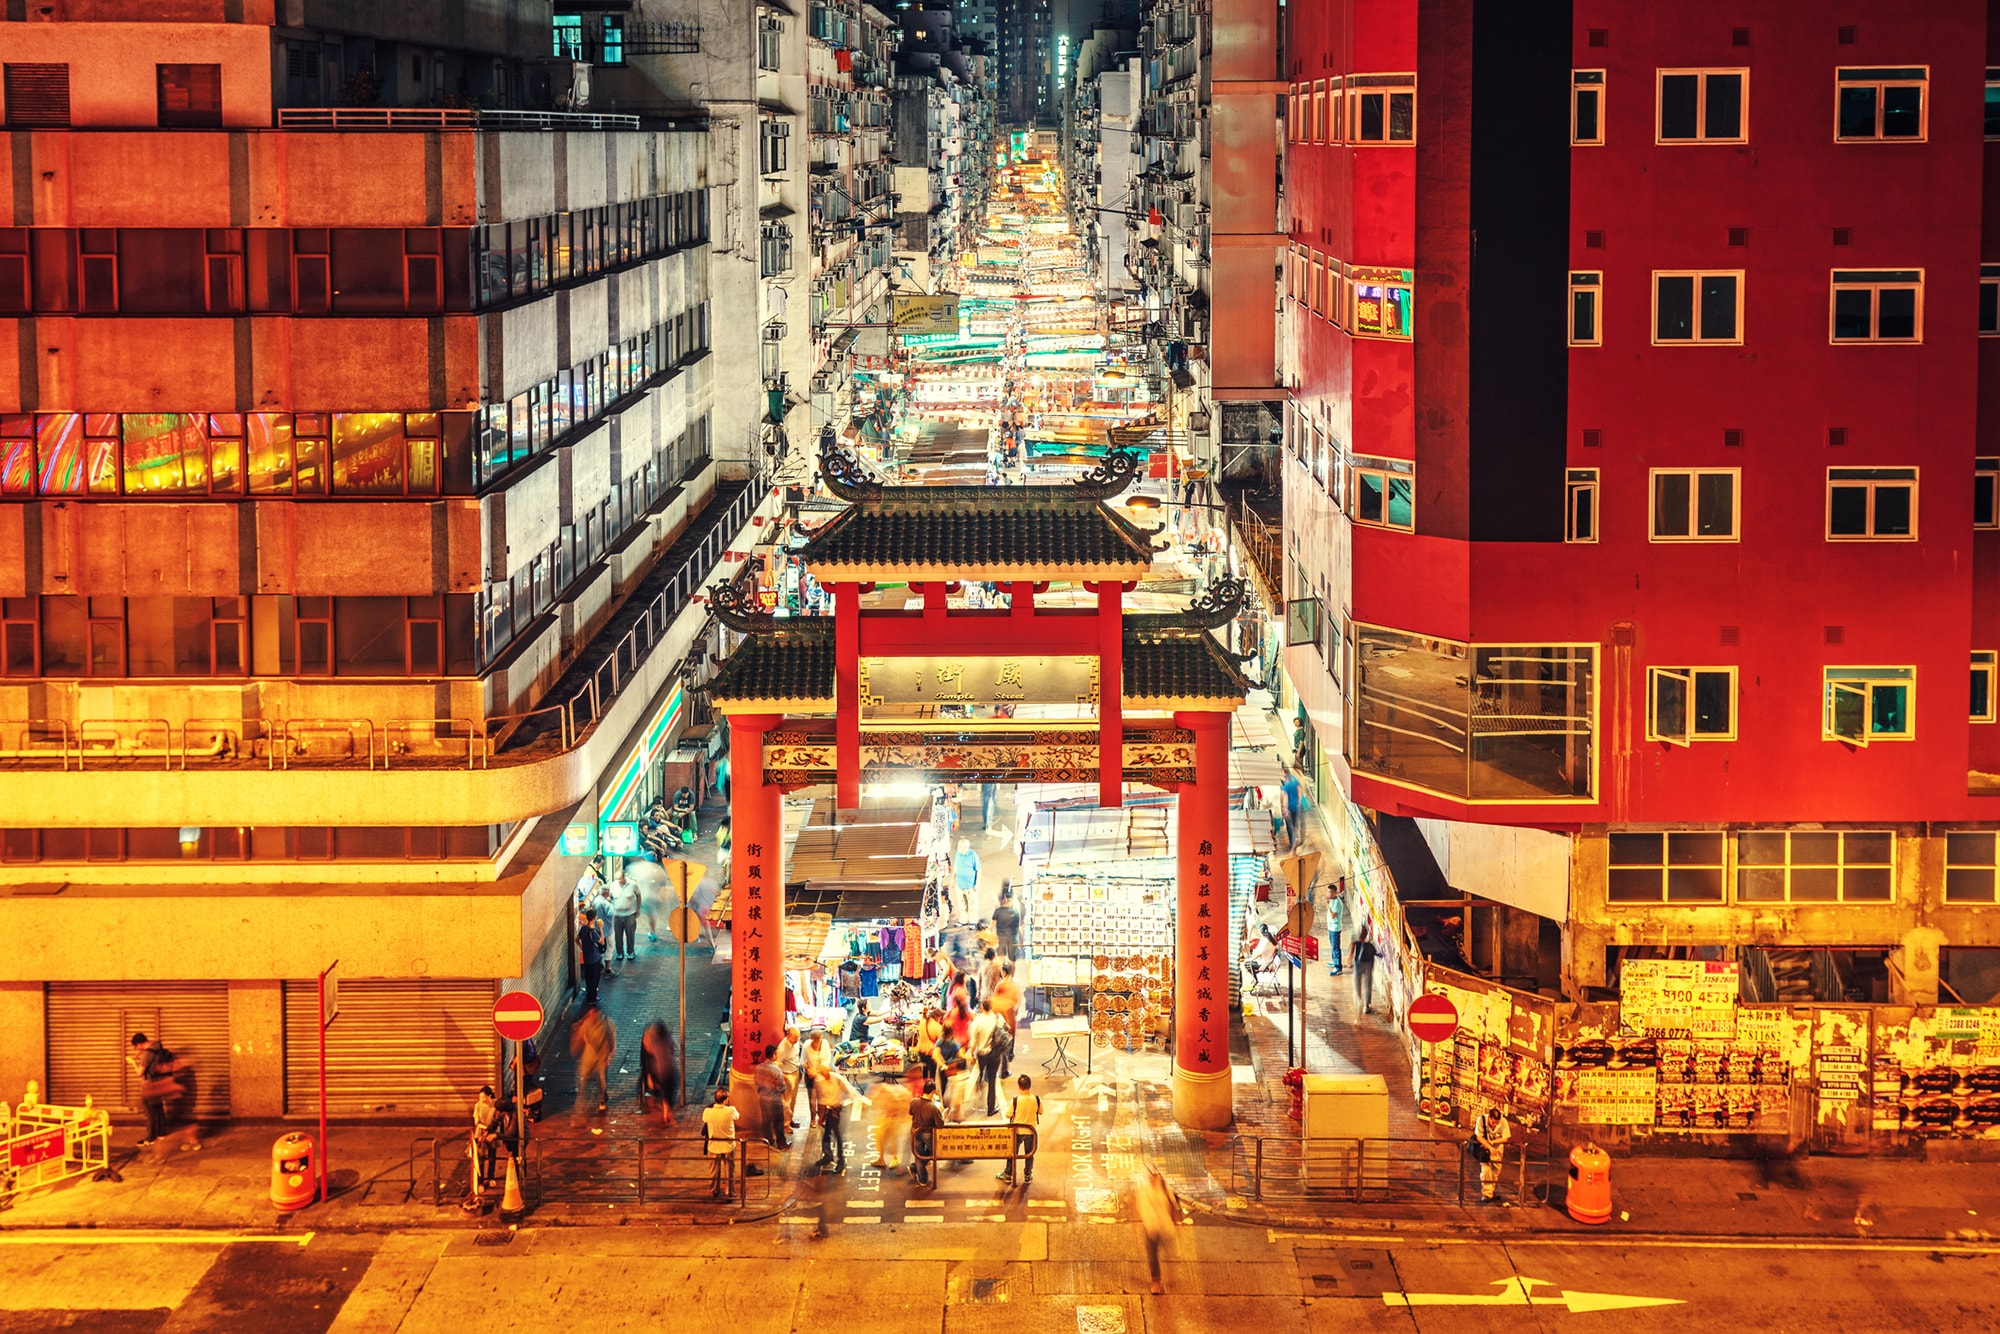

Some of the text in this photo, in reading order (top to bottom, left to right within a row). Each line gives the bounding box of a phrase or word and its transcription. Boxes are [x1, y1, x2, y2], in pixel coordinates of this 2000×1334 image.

[935, 692, 1025, 701] Temple Street
[1644, 1028, 1692, 1038] 2366 0772
[1737, 1029, 1781, 1041] 27811682
[1070, 1114, 1094, 1191] LOOK RIGHT
[858, 1163, 881, 1192] LEFT
